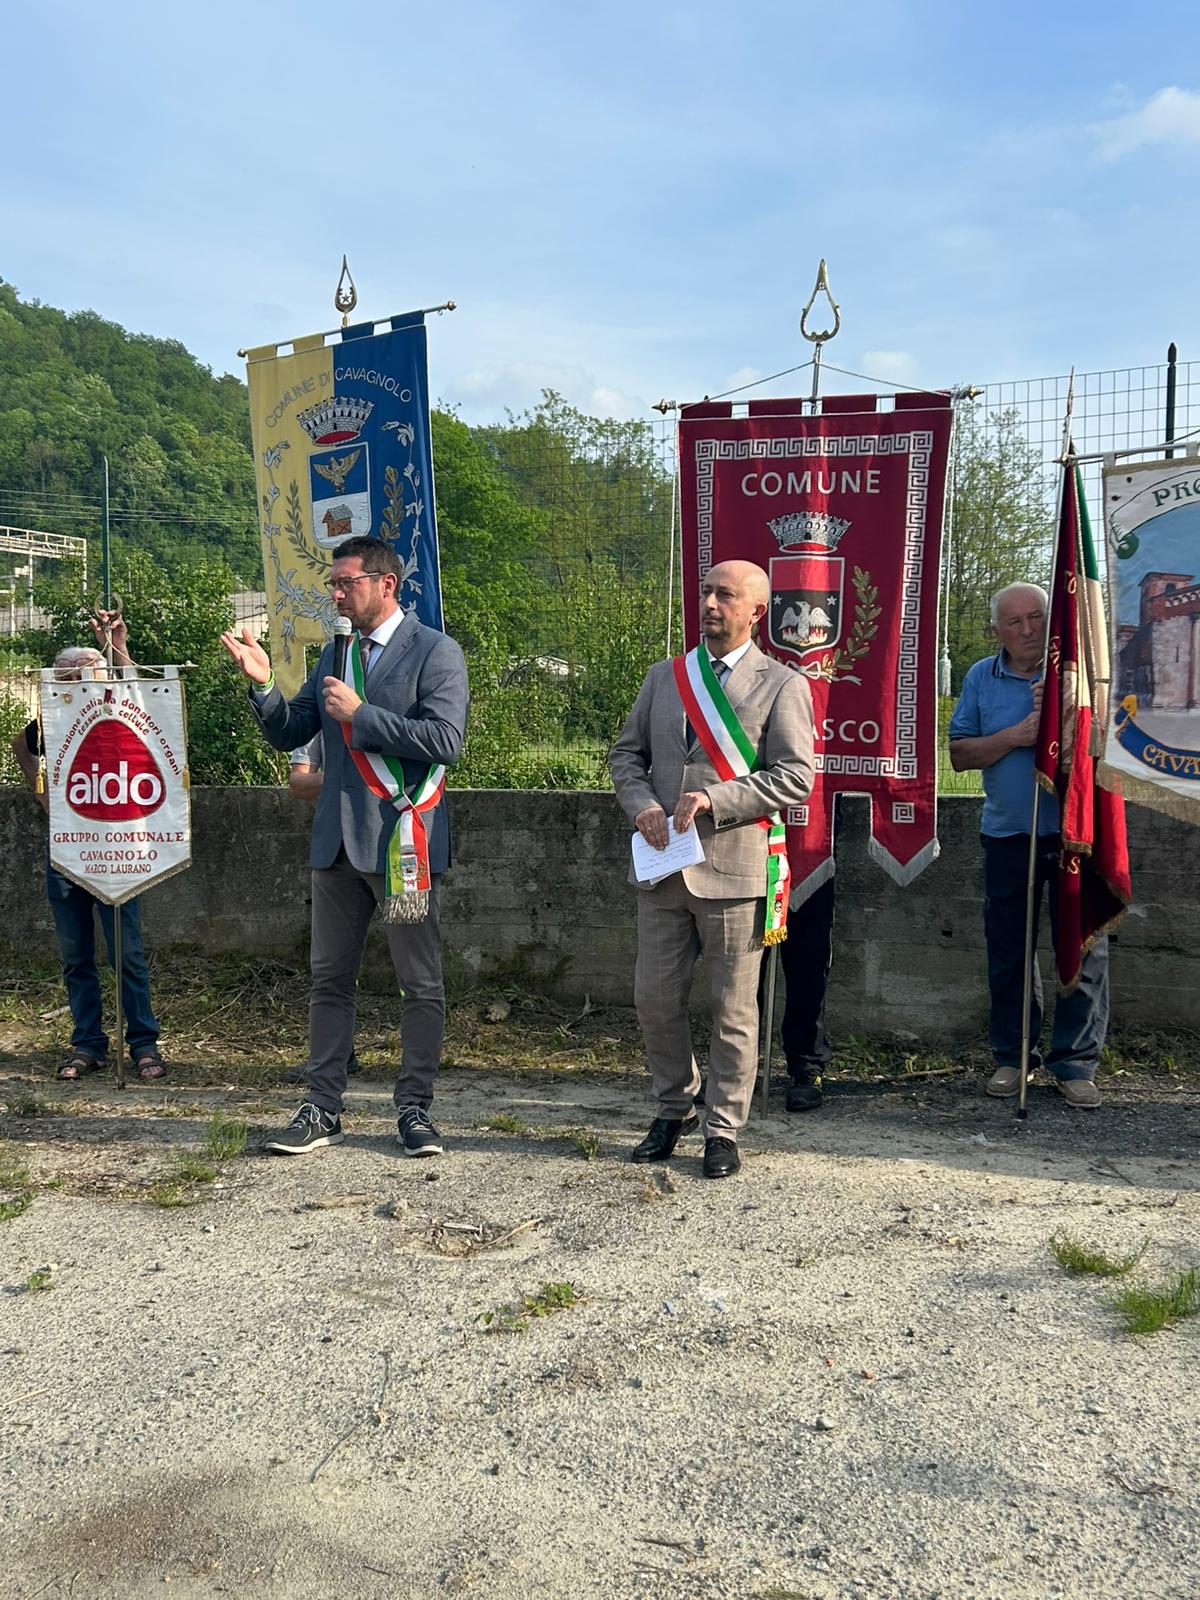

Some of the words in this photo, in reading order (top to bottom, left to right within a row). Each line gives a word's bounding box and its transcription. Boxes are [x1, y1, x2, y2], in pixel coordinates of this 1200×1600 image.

[265, 377, 315, 428] COMUNE
[318, 370, 331, 388] DI
[335, 367, 413, 403] CAVAGNOLO
[741, 470, 881, 497] COMUNE
[78, 709, 102, 736] tessuti
[118, 709, 150, 736] cellule
[53, 718, 81, 785] associazione
[121, 699, 162, 735] donatori
[160, 738, 181, 776] organi
[69, 761, 163, 806] aido
[53, 831, 100, 843] GRUPPO
[105, 831, 184, 843] COMUNALE
[80, 849, 158, 861] CAVAGNOLO
[84, 863, 107, 874] MARCO
[110, 863, 152, 875] LAURANO
